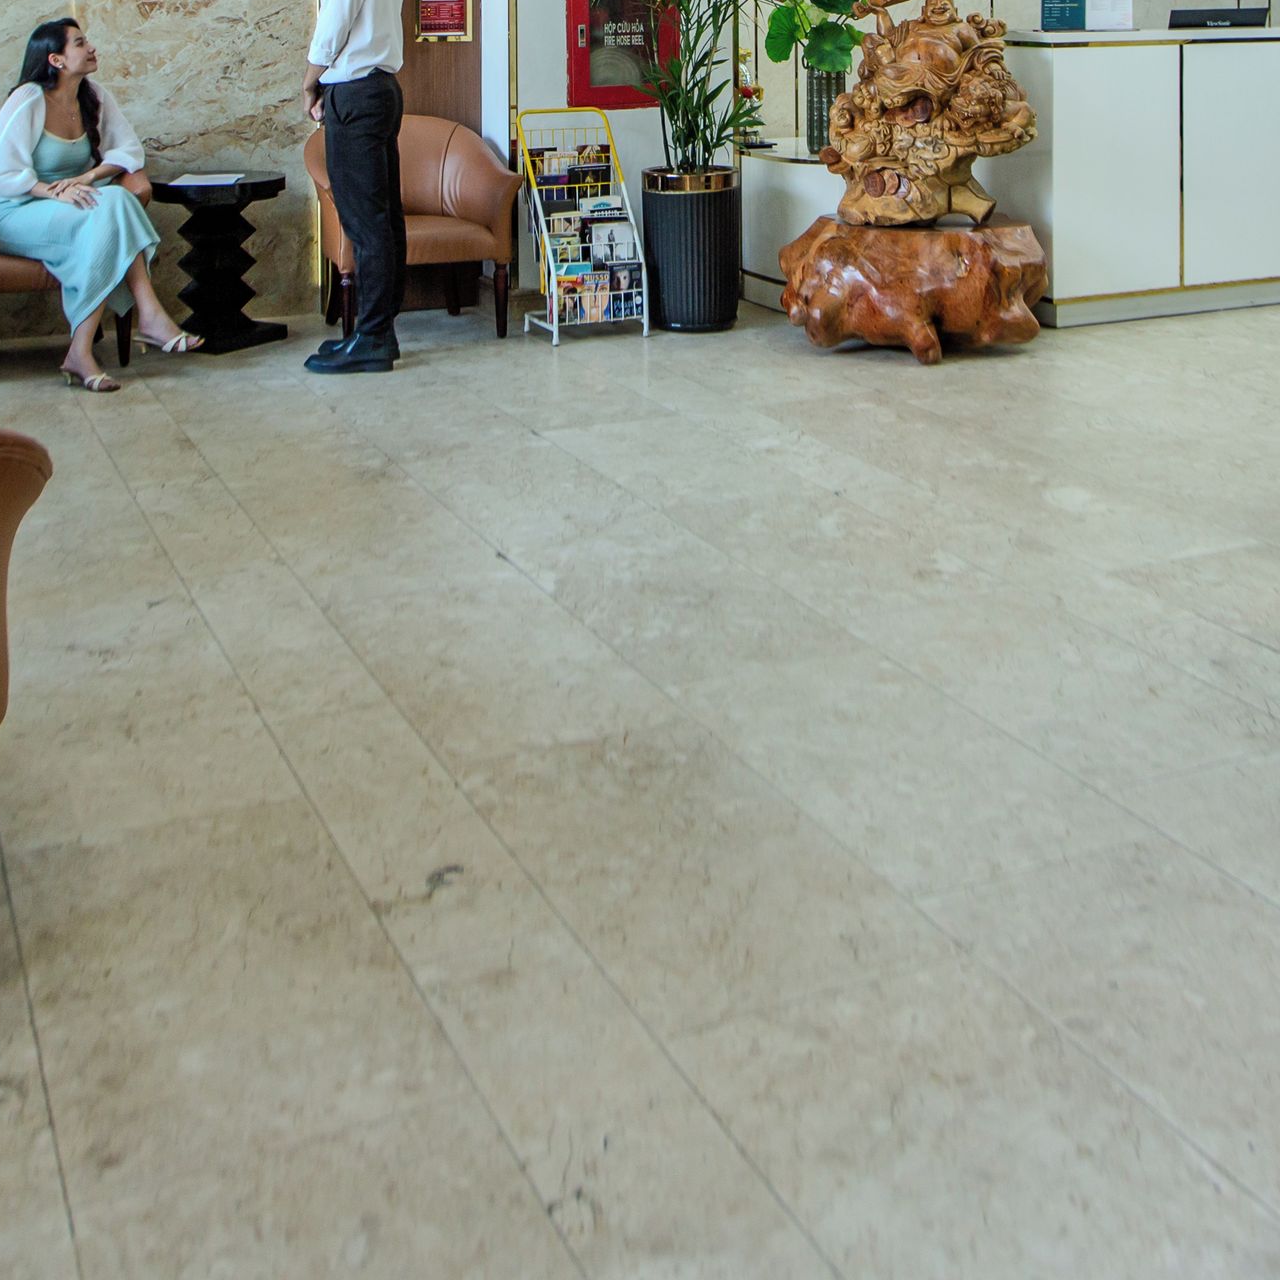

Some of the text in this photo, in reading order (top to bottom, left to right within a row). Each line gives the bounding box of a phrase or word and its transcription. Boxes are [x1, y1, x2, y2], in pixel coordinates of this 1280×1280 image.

[604, 35, 644, 46] FIRE HOSE REEL
